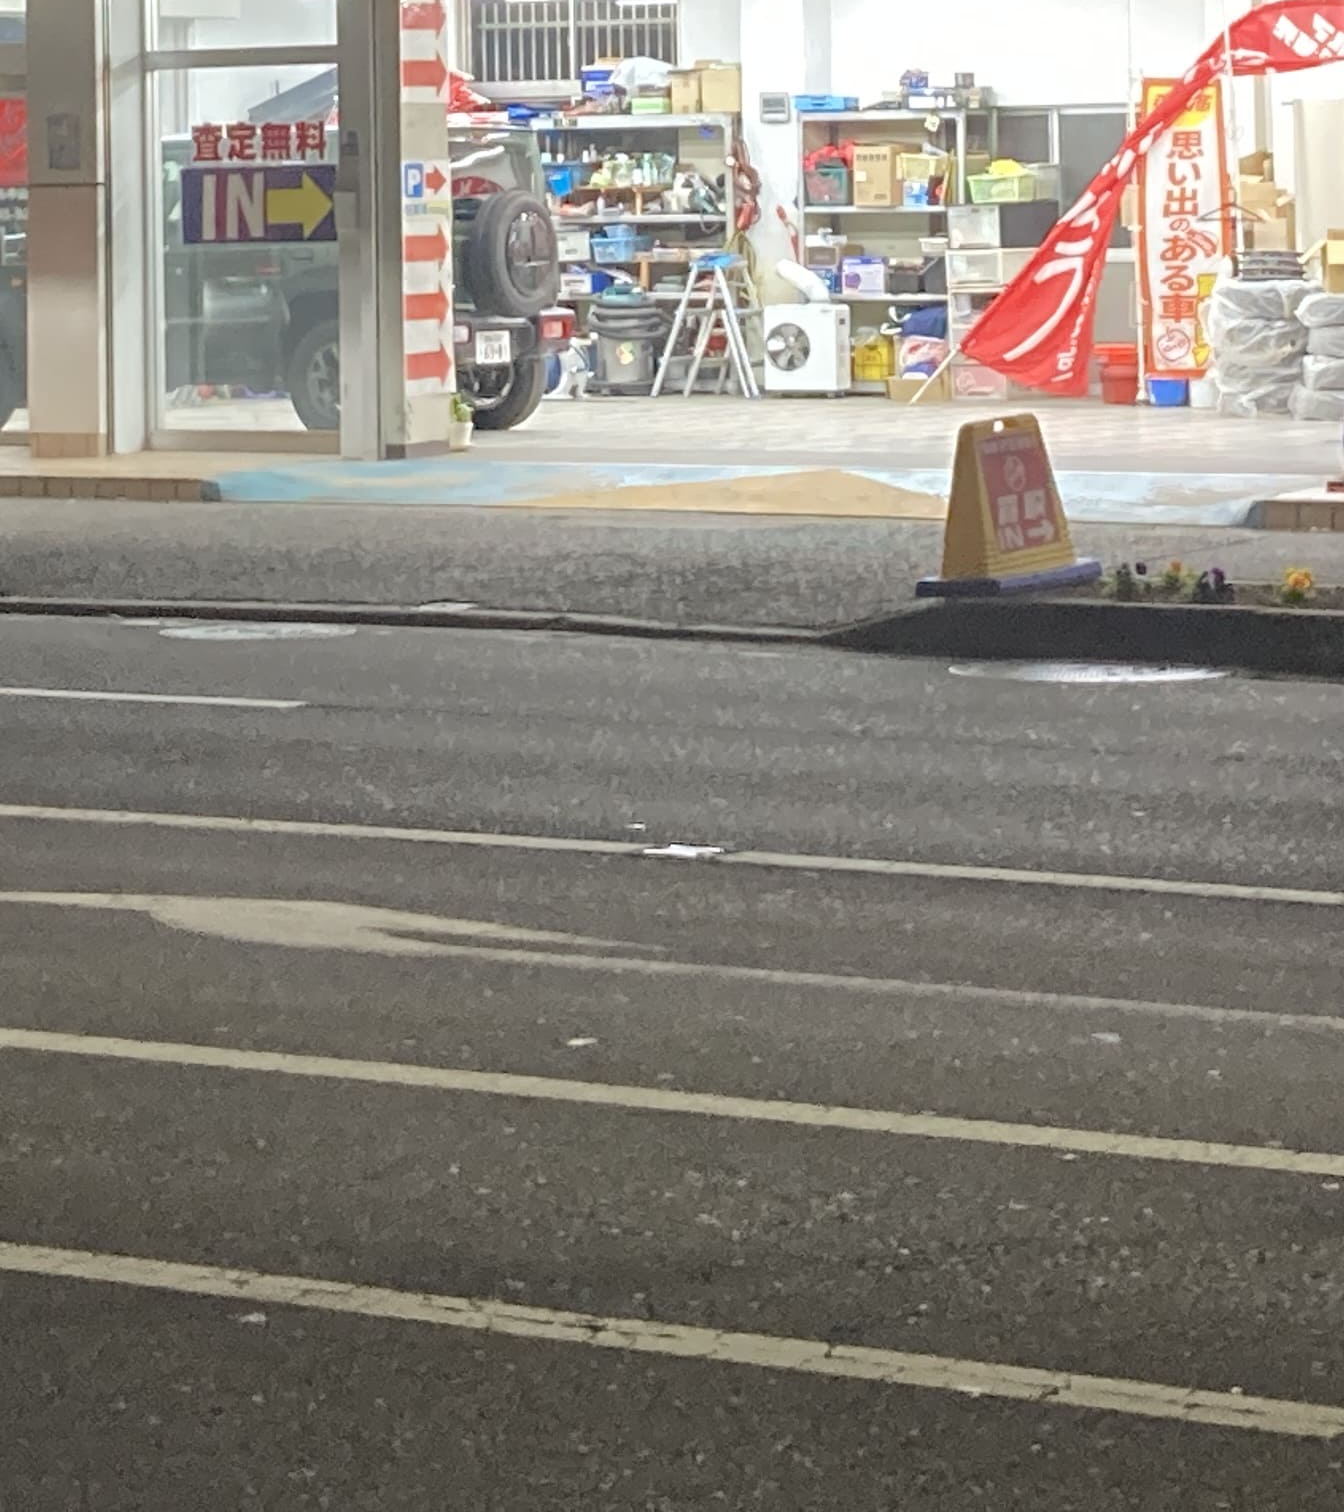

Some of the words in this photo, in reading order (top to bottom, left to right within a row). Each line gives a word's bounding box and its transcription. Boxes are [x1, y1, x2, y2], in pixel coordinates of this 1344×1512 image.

[191, 121, 327, 161] 査定無料
[200, 172, 265, 241] IN
[1158, 130, 1204, 324] 思い出のある車
